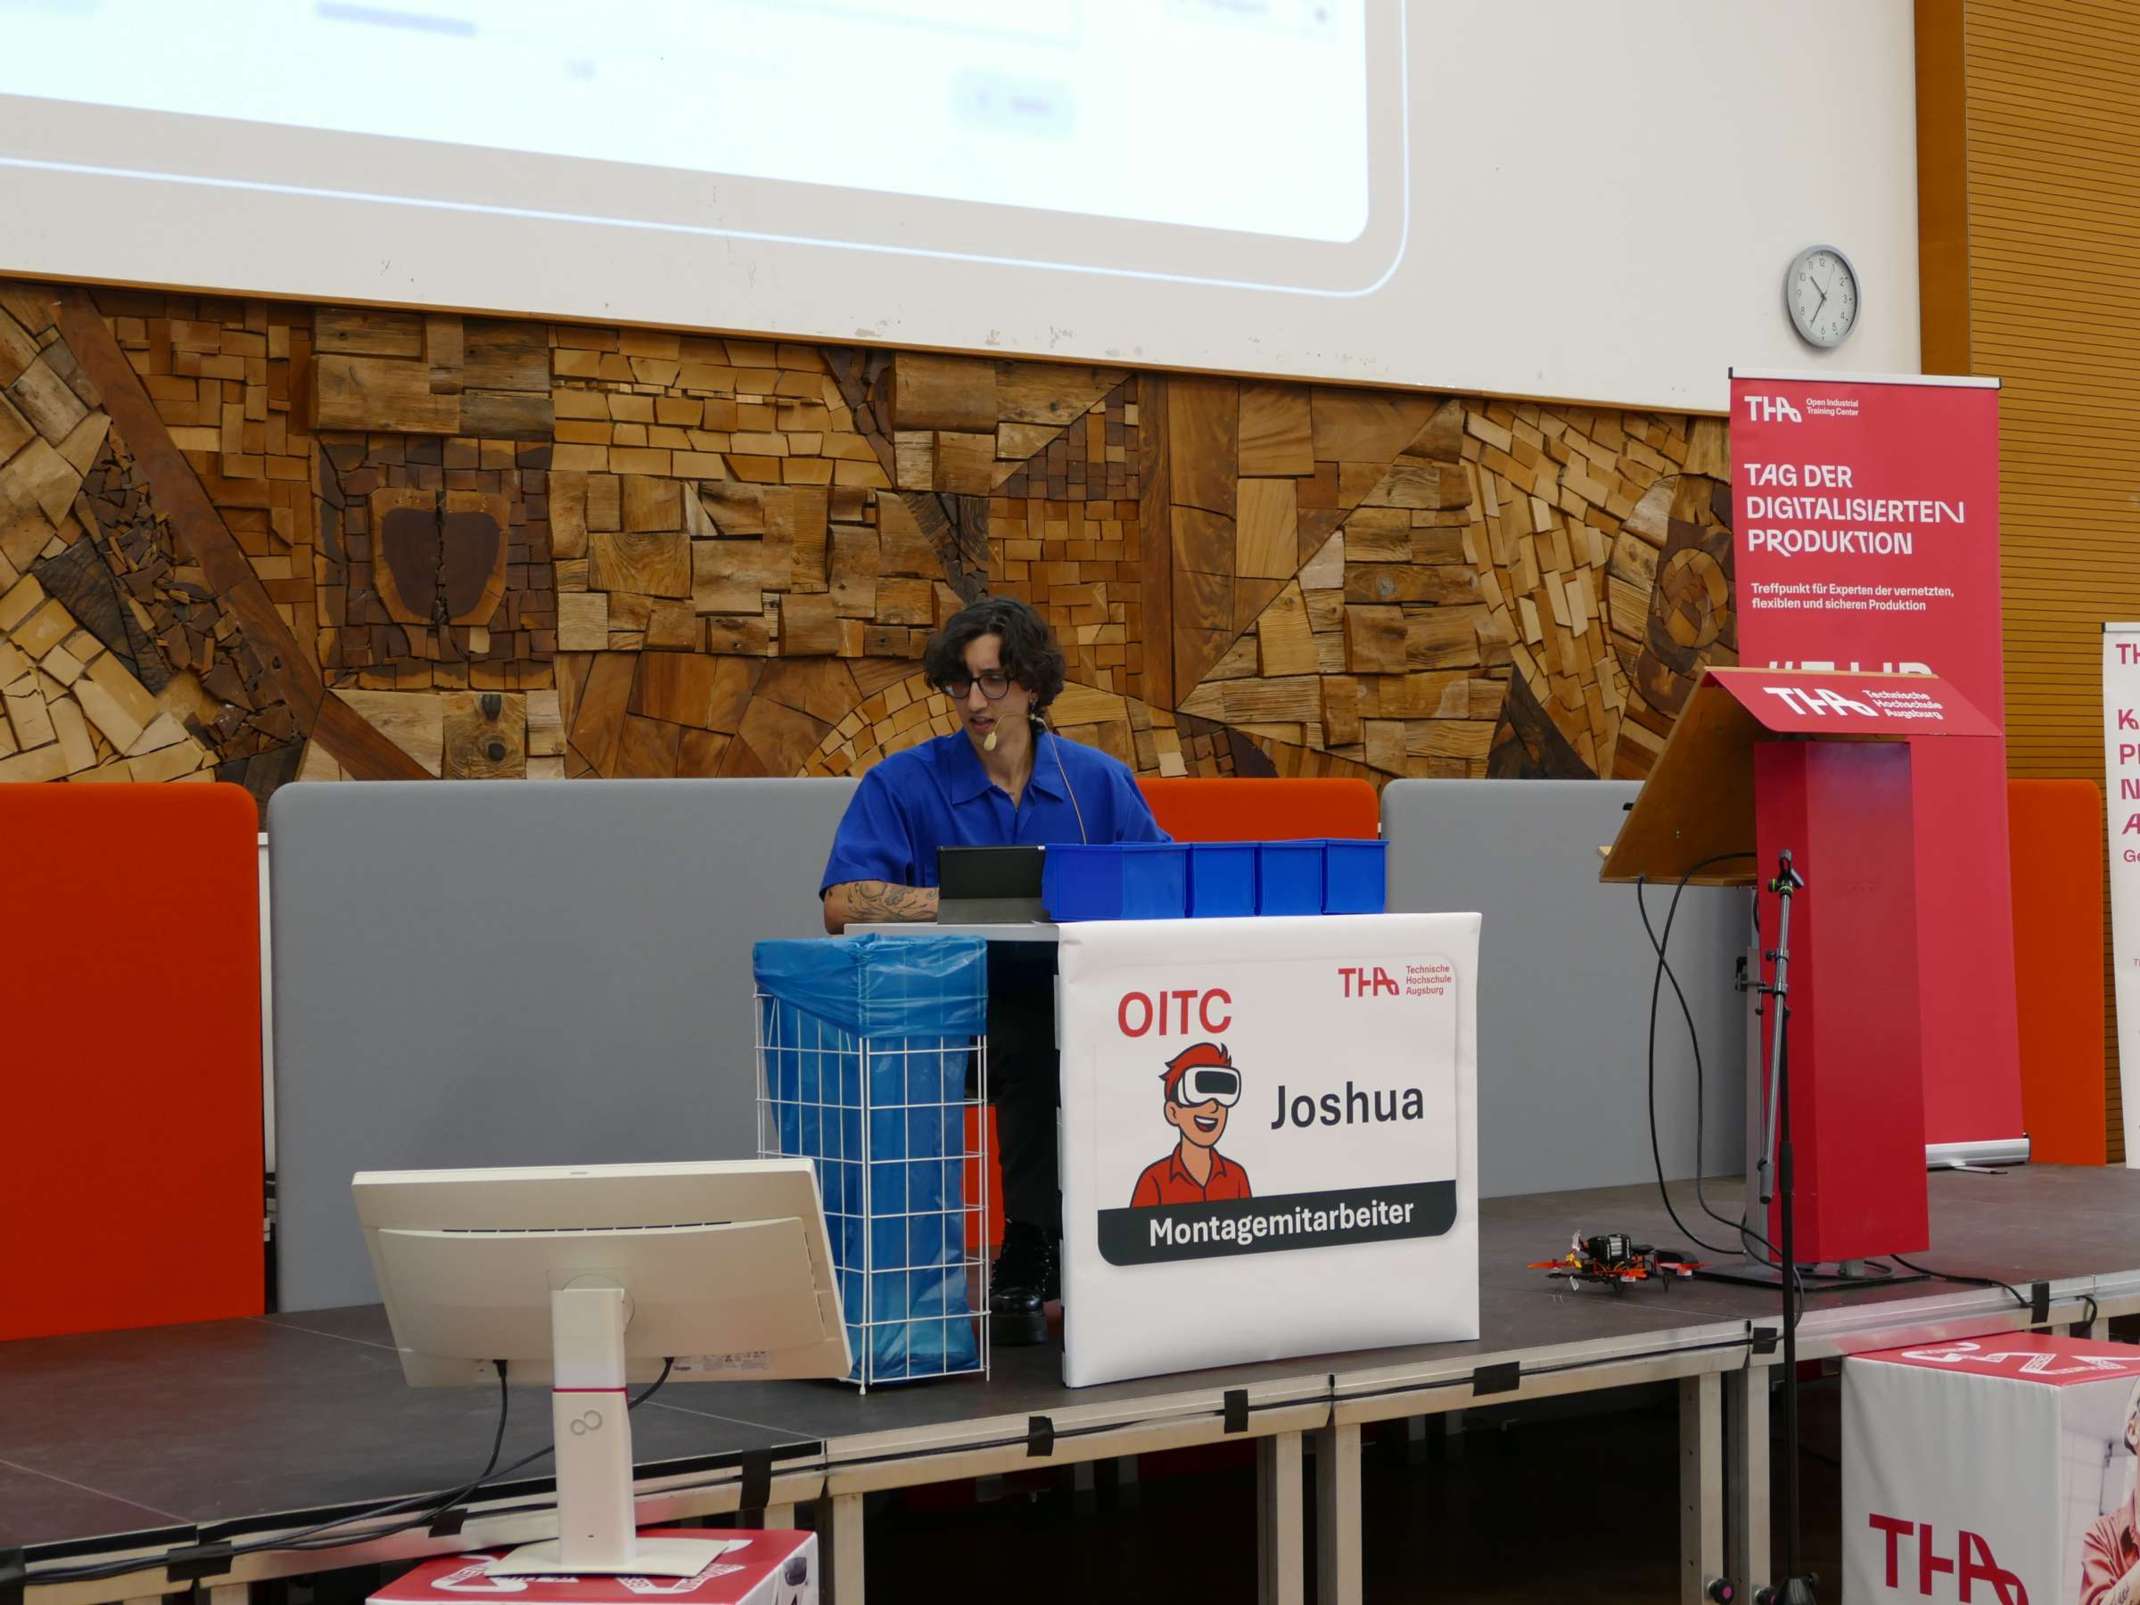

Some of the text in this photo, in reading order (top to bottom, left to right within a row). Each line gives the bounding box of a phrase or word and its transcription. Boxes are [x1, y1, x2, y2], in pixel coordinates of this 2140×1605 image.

[1744, 395, 1802, 423] THA
[1806, 398, 1859, 408] Open Industrial
[1807, 407, 1859, 416] Training Center
[1744, 463, 1853, 488] TAG DER
[1746, 496, 1965, 524] DIGITALISIERTEN
[1748, 529, 1913, 557] PRODUKTION
[1751, 583, 1955, 598] Treffpunkt für Experten der vernetzten,
[1752, 597, 1926, 611] flexiblen und sicheren Produktion
[1762, 687, 1880, 717] THA
[1862, 689, 1931, 701] Technische
[1872, 699, 1943, 710] Hochschule
[1884, 708, 1944, 720] Augsburg
[1406, 963, 1451, 975] Technische
[1338, 966, 1400, 998] THA
[1406, 975, 1452, 985] Hochschule
[1406, 986, 1444, 997] Augsburg
[1117, 987, 1232, 1037] OITC
[1271, 1081, 1425, 1130] Joshua
[1149, 1200, 1414, 1247] Montagemitarbeiter
